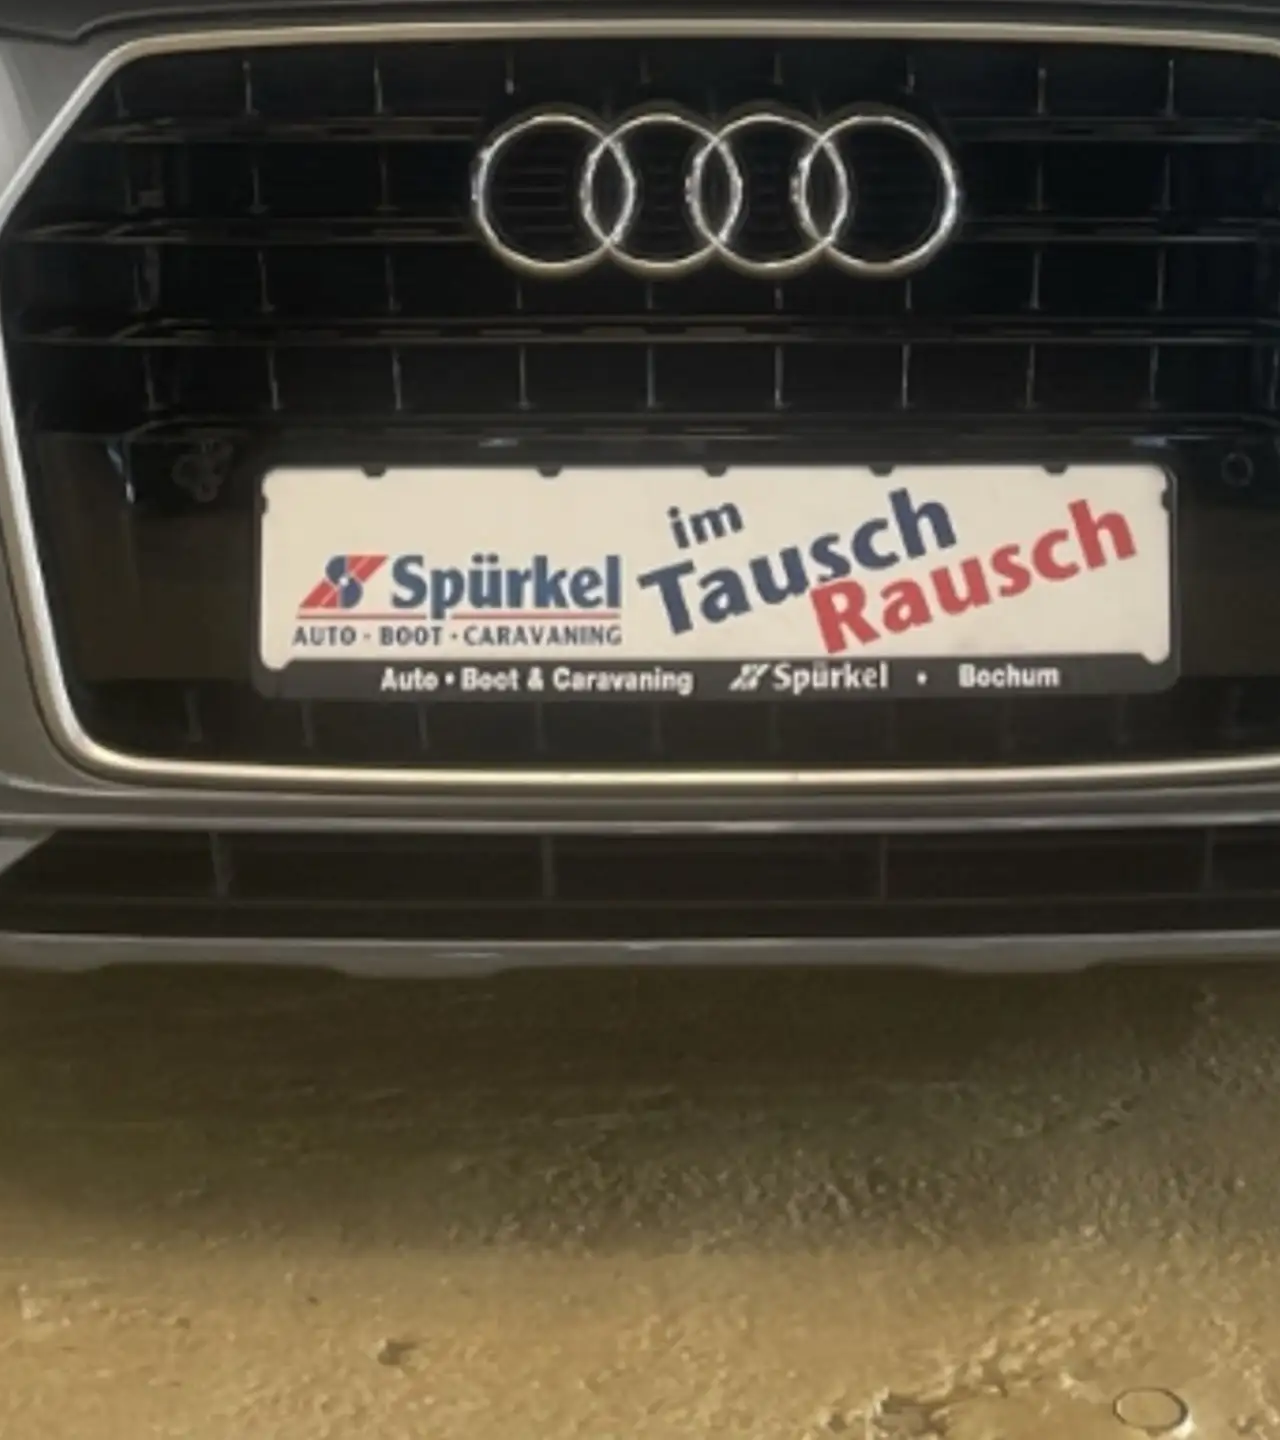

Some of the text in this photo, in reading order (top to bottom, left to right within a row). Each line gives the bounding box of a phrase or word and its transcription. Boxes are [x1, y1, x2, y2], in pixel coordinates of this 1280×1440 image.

[668, 502, 744, 550] im
[390, 553, 623, 620] Spürkel
[637, 487, 958, 635] Tausch
[809, 499, 1138, 655] Rausch
[293, 625, 623, 647] AUTO BOOT CARAVANING
[380, 661, 1060, 696] Auto Boot & Caravaning Spürkel Bochum
